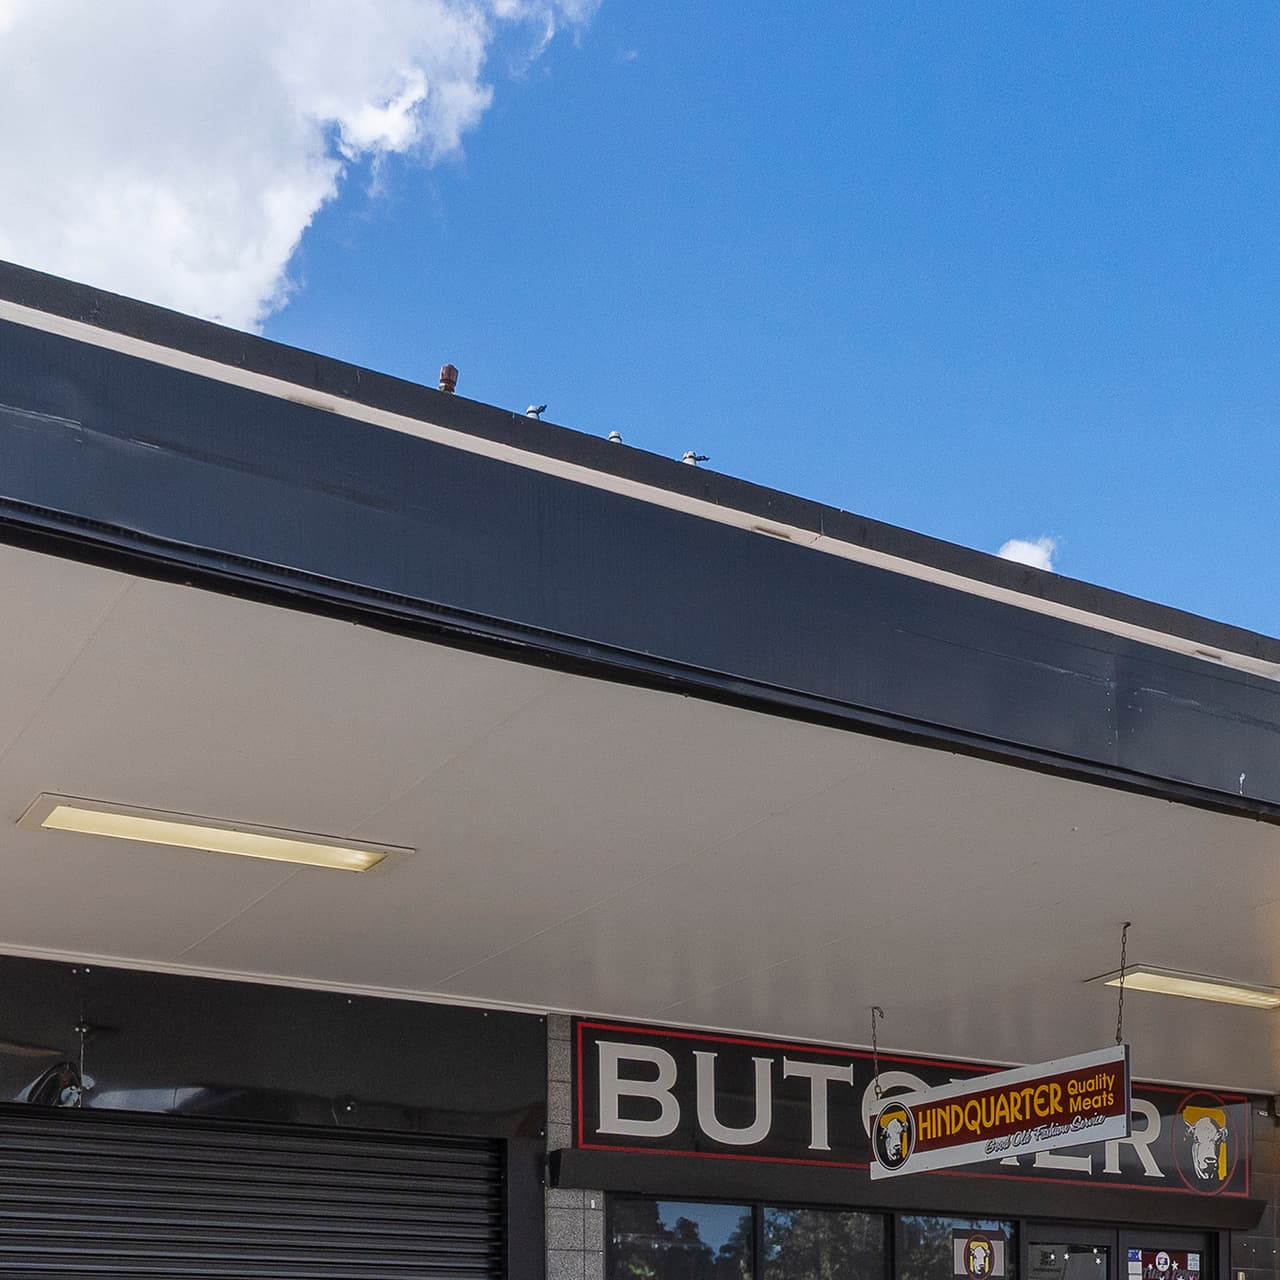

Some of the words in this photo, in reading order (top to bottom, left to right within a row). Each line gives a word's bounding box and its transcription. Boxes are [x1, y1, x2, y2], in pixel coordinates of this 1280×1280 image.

[1067, 1072, 1117, 1097] Quality
[919, 1082, 1064, 1142] HINDQUARTER
[1069, 1091, 1114, 1113] Meats
[985, 1134, 1012, 1154] Good
[1012, 1127, 1032, 1147] Old
[1032, 1121, 1071, 1142] Fashion
[1071, 1112, 1106, 1133] Service
